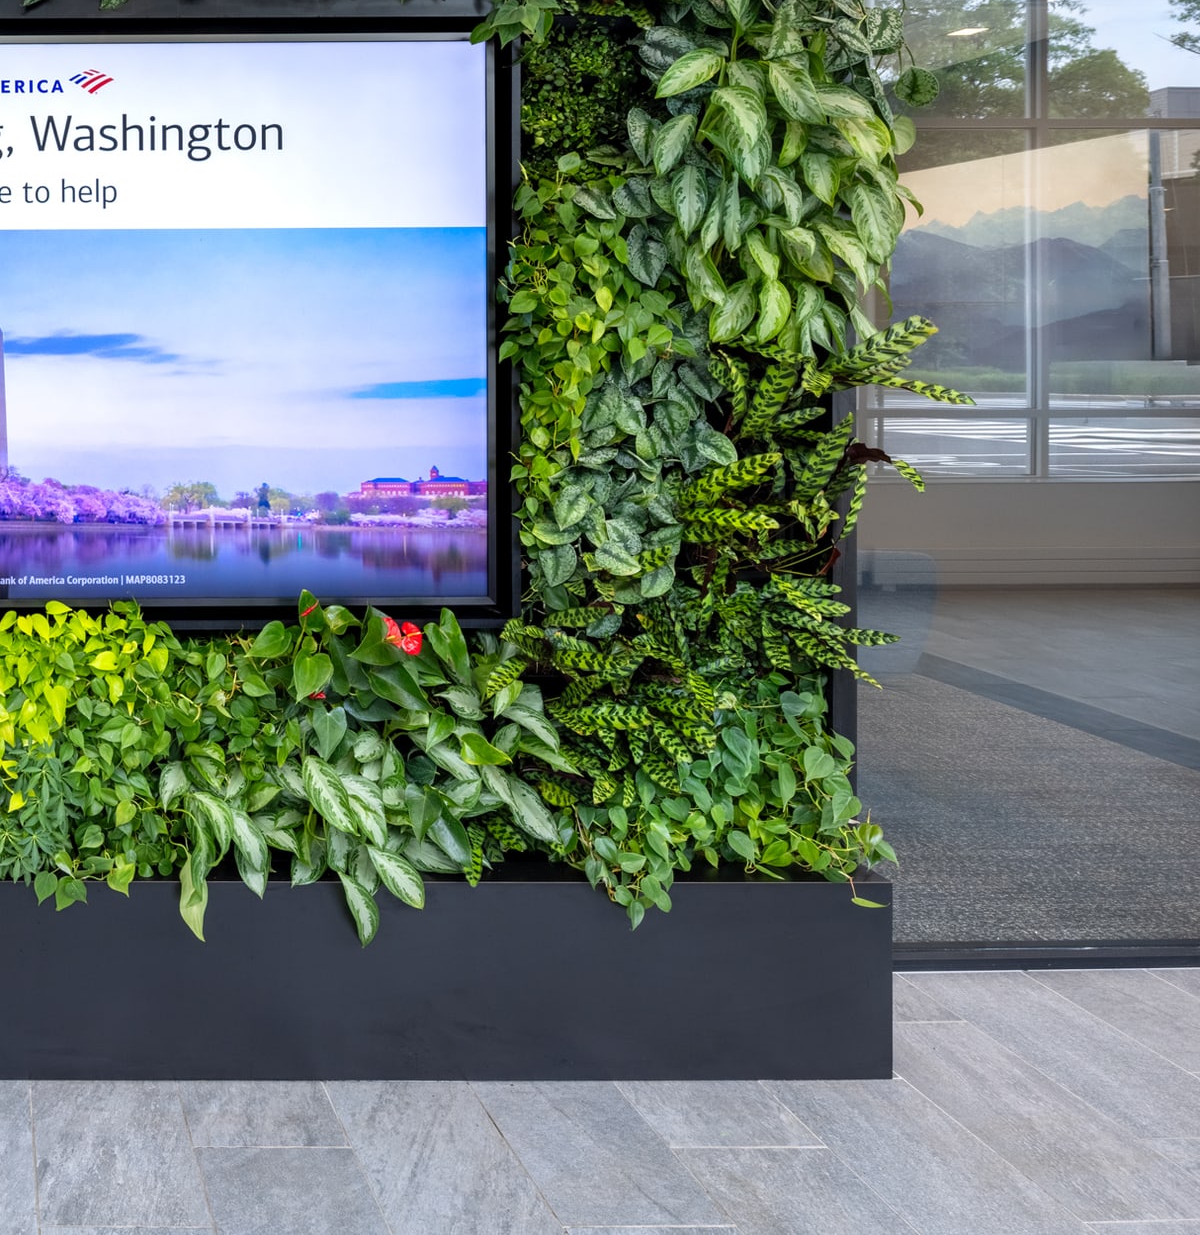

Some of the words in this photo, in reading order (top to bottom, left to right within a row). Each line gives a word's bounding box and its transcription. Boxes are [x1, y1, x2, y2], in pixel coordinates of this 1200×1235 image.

[29, 113, 283, 162] Washington
[22, 181, 51, 204] to
[61, 177, 118, 210] help
[17, 575, 28, 586] of
[28, 575, 66, 585] America
[66, 575, 119, 587] Corporation
[125, 574, 186, 585] MAP8083123
